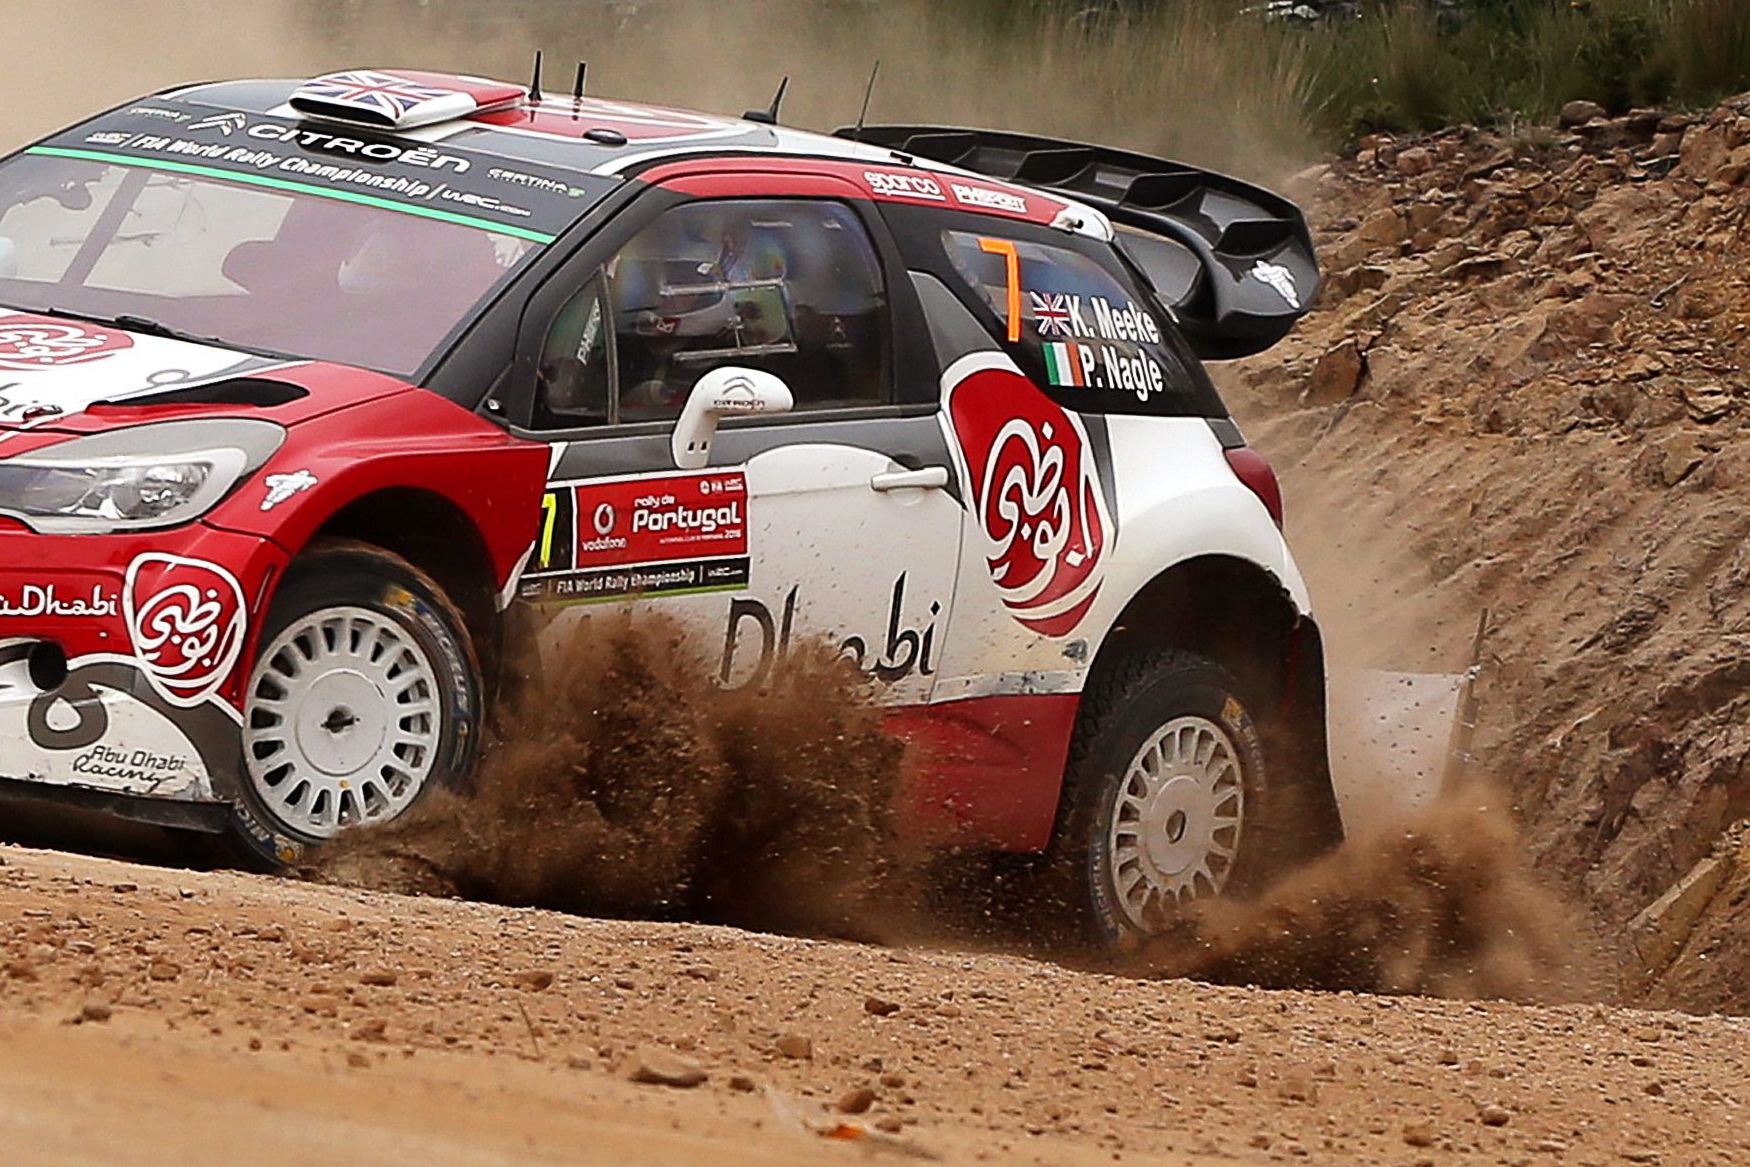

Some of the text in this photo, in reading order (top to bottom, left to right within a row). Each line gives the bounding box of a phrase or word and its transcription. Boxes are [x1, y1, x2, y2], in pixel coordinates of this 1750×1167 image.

[167, 138, 228, 158] World
[224, 146, 283, 168] Rally
[279, 157, 431, 200] Championship
[864, 171, 942, 196] sparco
[977, 237, 1021, 343] 7
[1065, 294, 1159, 345] K. Meeke
[1079, 344, 1165, 403] P. Nagle
[632, 501, 742, 533] Portugal
[634, 495, 660, 509] rally
[11, 583, 118, 618] Dhabi
[72, 753, 177, 794] Racing
[90, 745, 187, 771] Abu Dhabi
